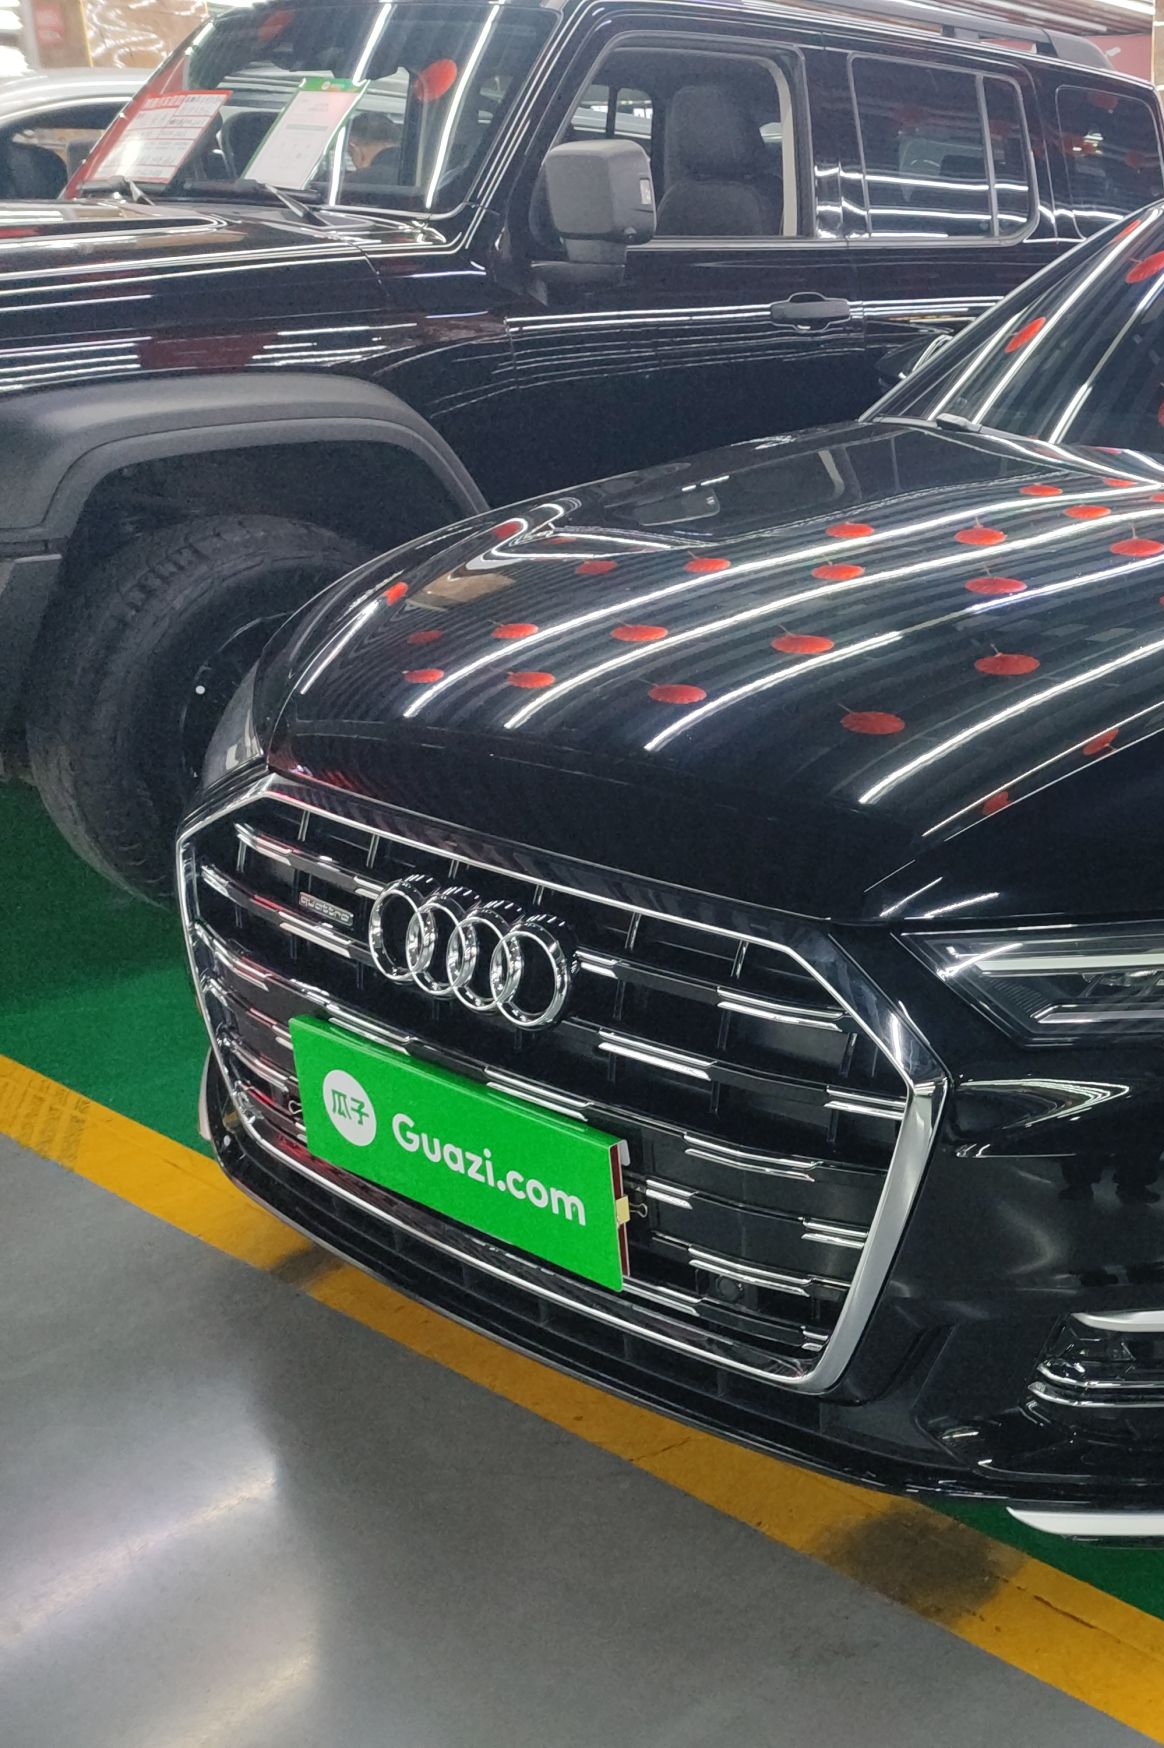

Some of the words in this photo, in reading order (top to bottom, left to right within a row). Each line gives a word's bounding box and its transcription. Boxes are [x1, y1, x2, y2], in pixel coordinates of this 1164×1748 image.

[300, 895, 350, 922] quattro
[331, 1088, 370, 1126] 瓜子
[391, 1112, 586, 1226] Guazi.com
